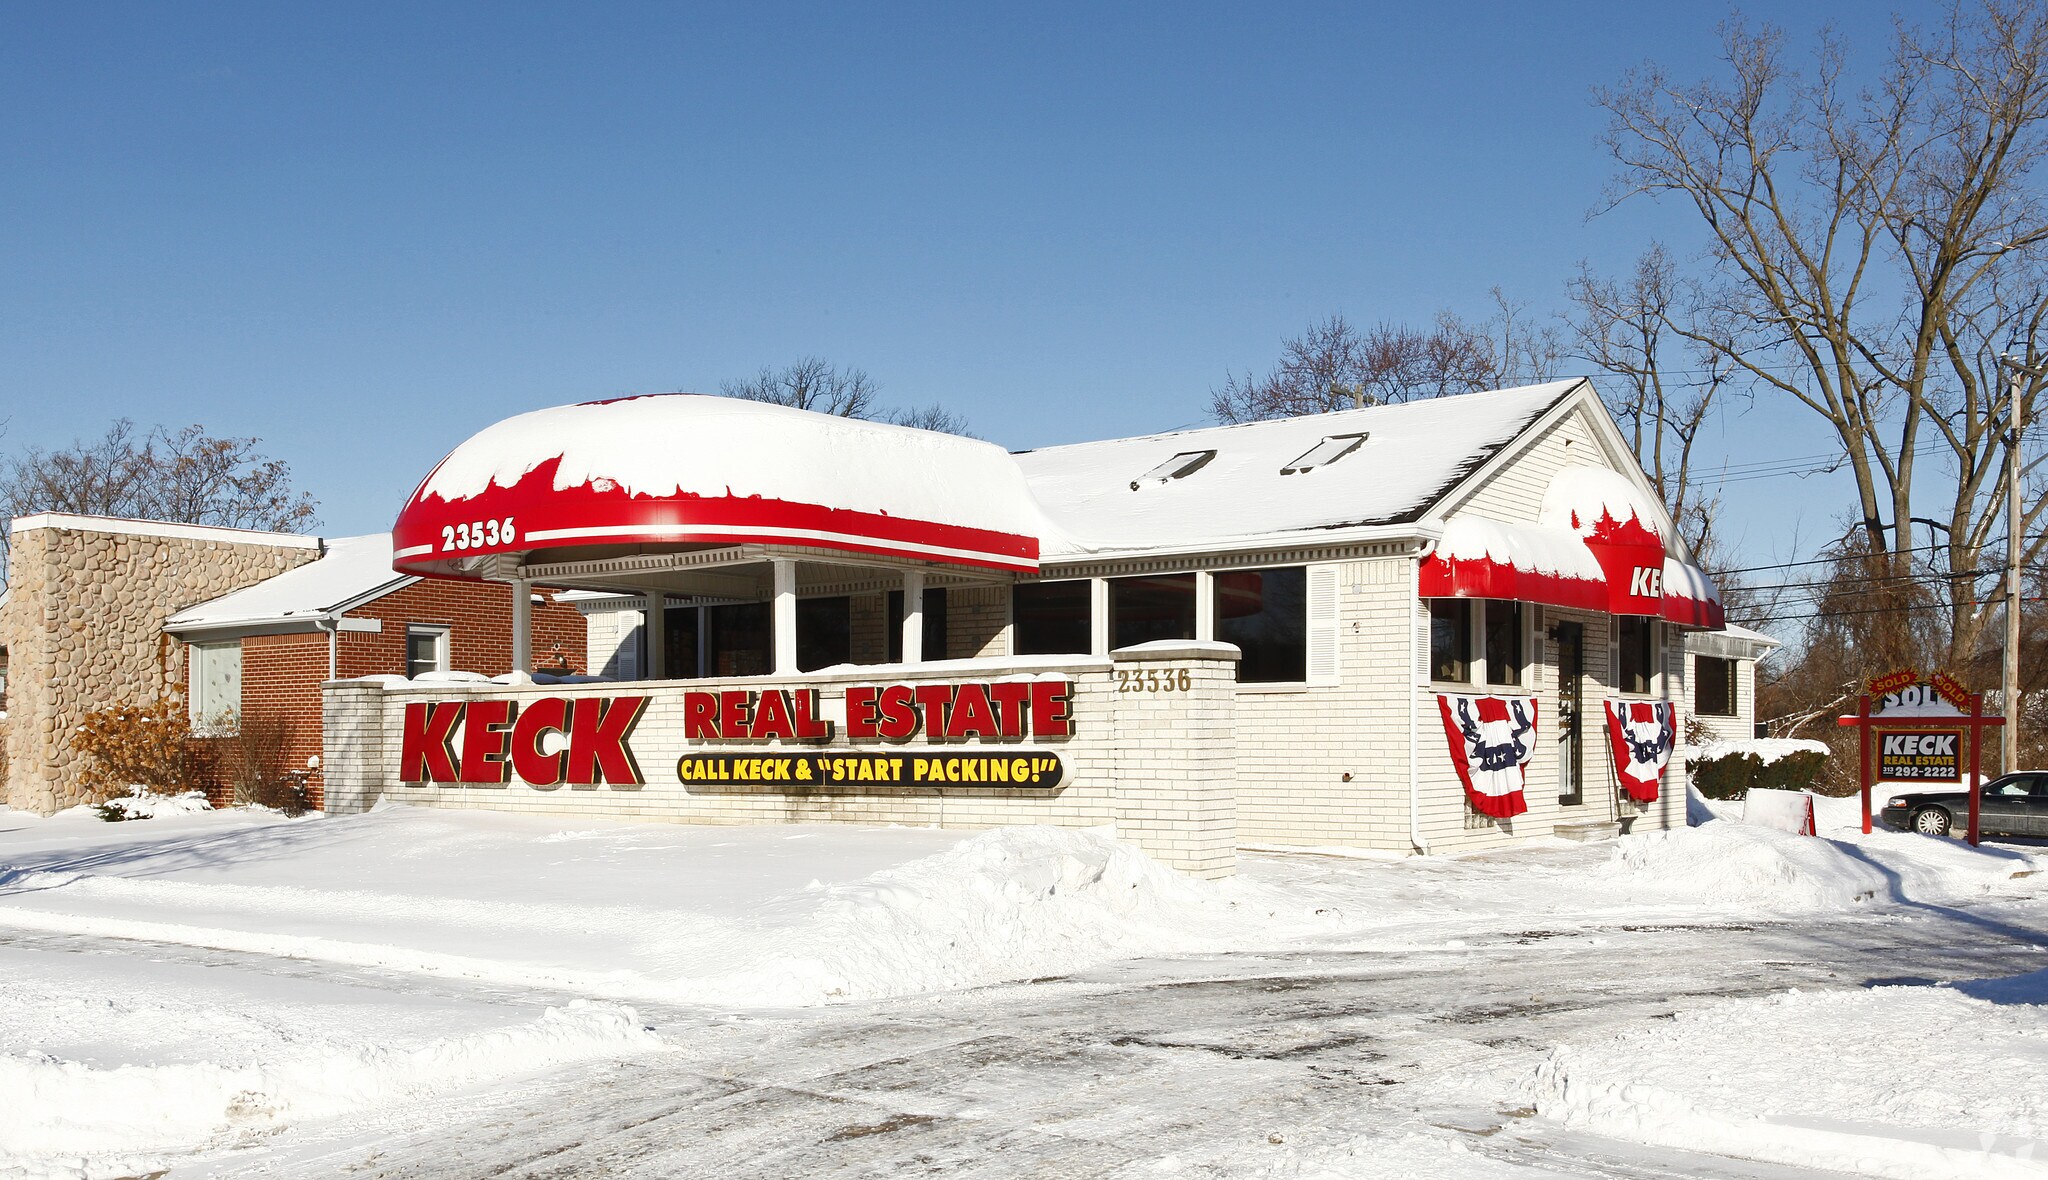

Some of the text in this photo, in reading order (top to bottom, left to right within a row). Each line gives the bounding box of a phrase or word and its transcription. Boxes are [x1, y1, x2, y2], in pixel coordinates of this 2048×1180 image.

[441, 517, 516, 552] 23536
[1630, 565, 1664, 599] KE
[1118, 667, 1191, 693] 23536
[1876, 674, 1910, 690] SOLD
[1936, 677, 1966, 703] SOLD
[684, 680, 1071, 739] REAL ESTATE
[400, 696, 650, 786] KECK
[1883, 735, 1956, 755] KECK
[680, 759, 729, 781] CALL
[732, 758, 792, 781] KECK
[795, 758, 813, 781] &
[913, 757, 1058, 783] PACKING!"
[1883, 756, 1955, 766] REAL ESTATE
[1895, 766, 1955, 777] 292-2222
